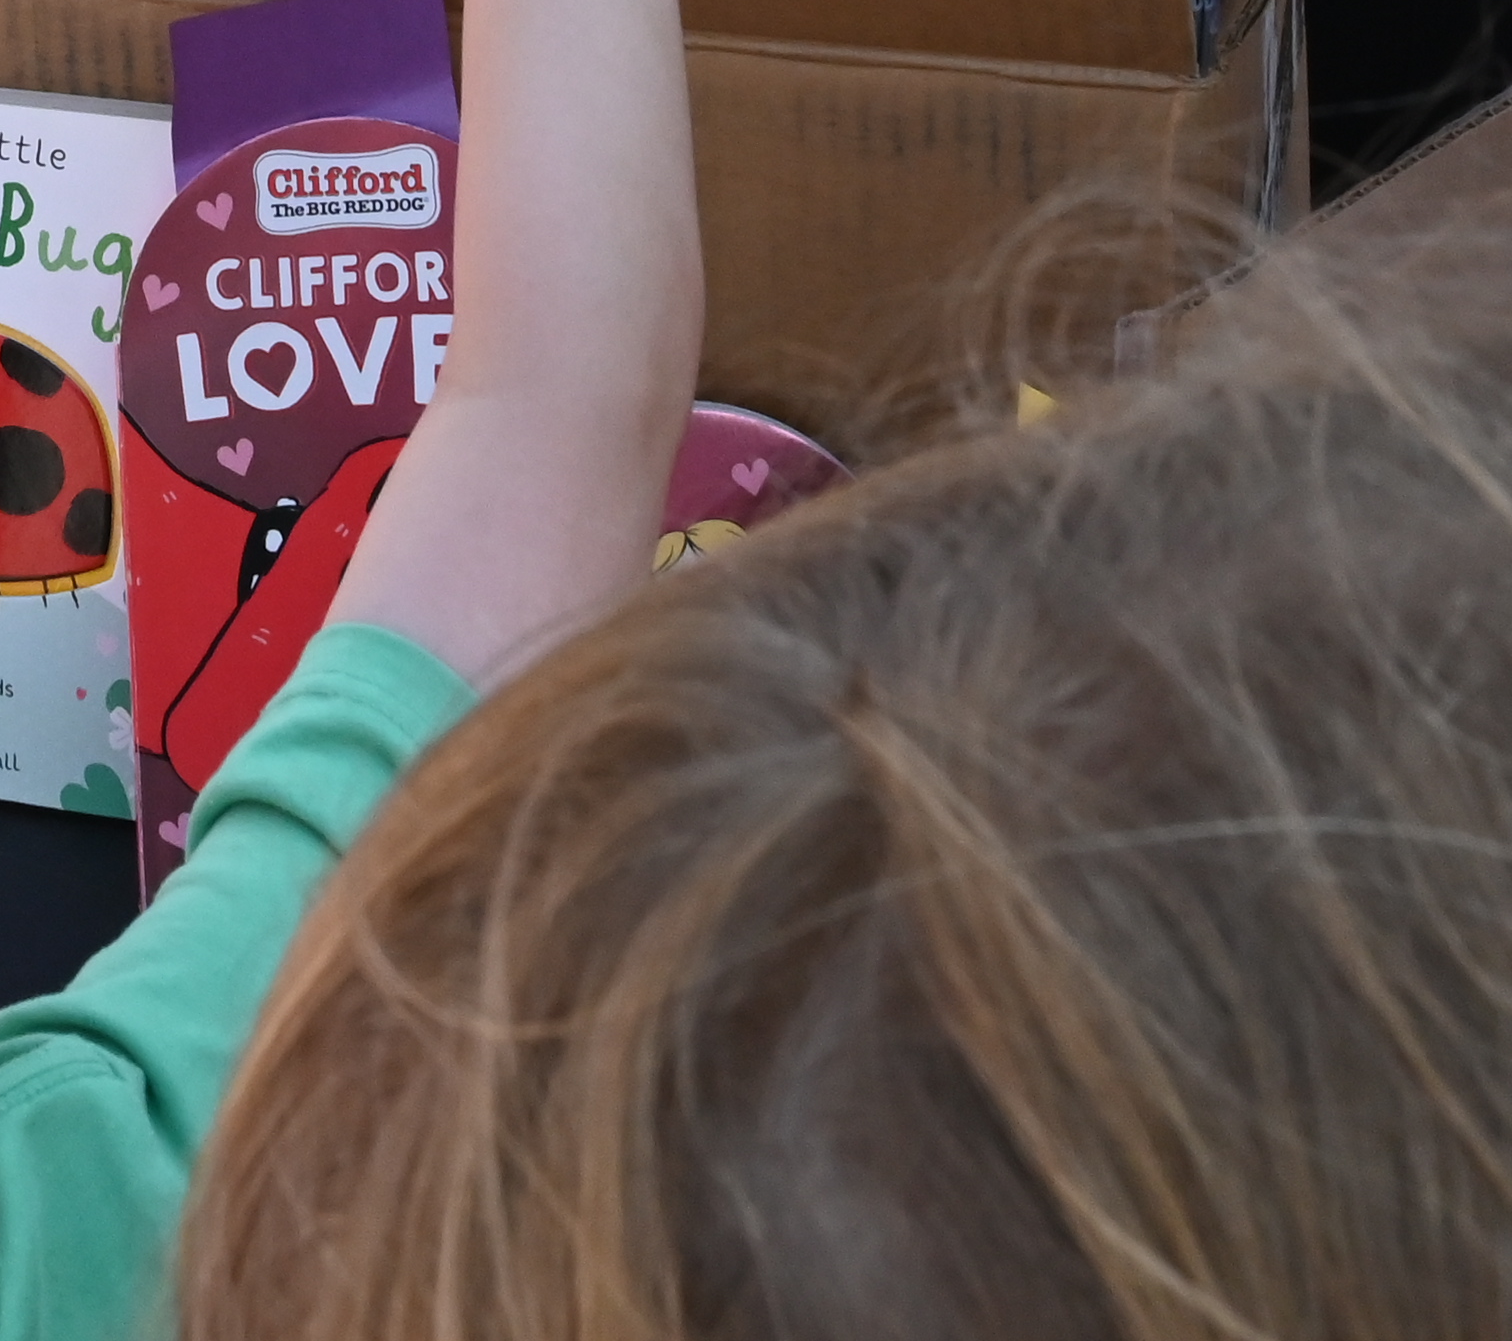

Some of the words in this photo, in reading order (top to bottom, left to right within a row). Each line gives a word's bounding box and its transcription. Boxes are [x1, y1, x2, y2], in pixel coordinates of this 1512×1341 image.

[267, 163, 427, 199] Clifford
[271, 202, 305, 218] The
[307, 201, 342, 216] BIG
[343, 199, 384, 214] RED
[385, 197, 426, 214] DOG
[205, 250, 450, 311] CLIFFOR
[176, 313, 455, 423] LOVE
